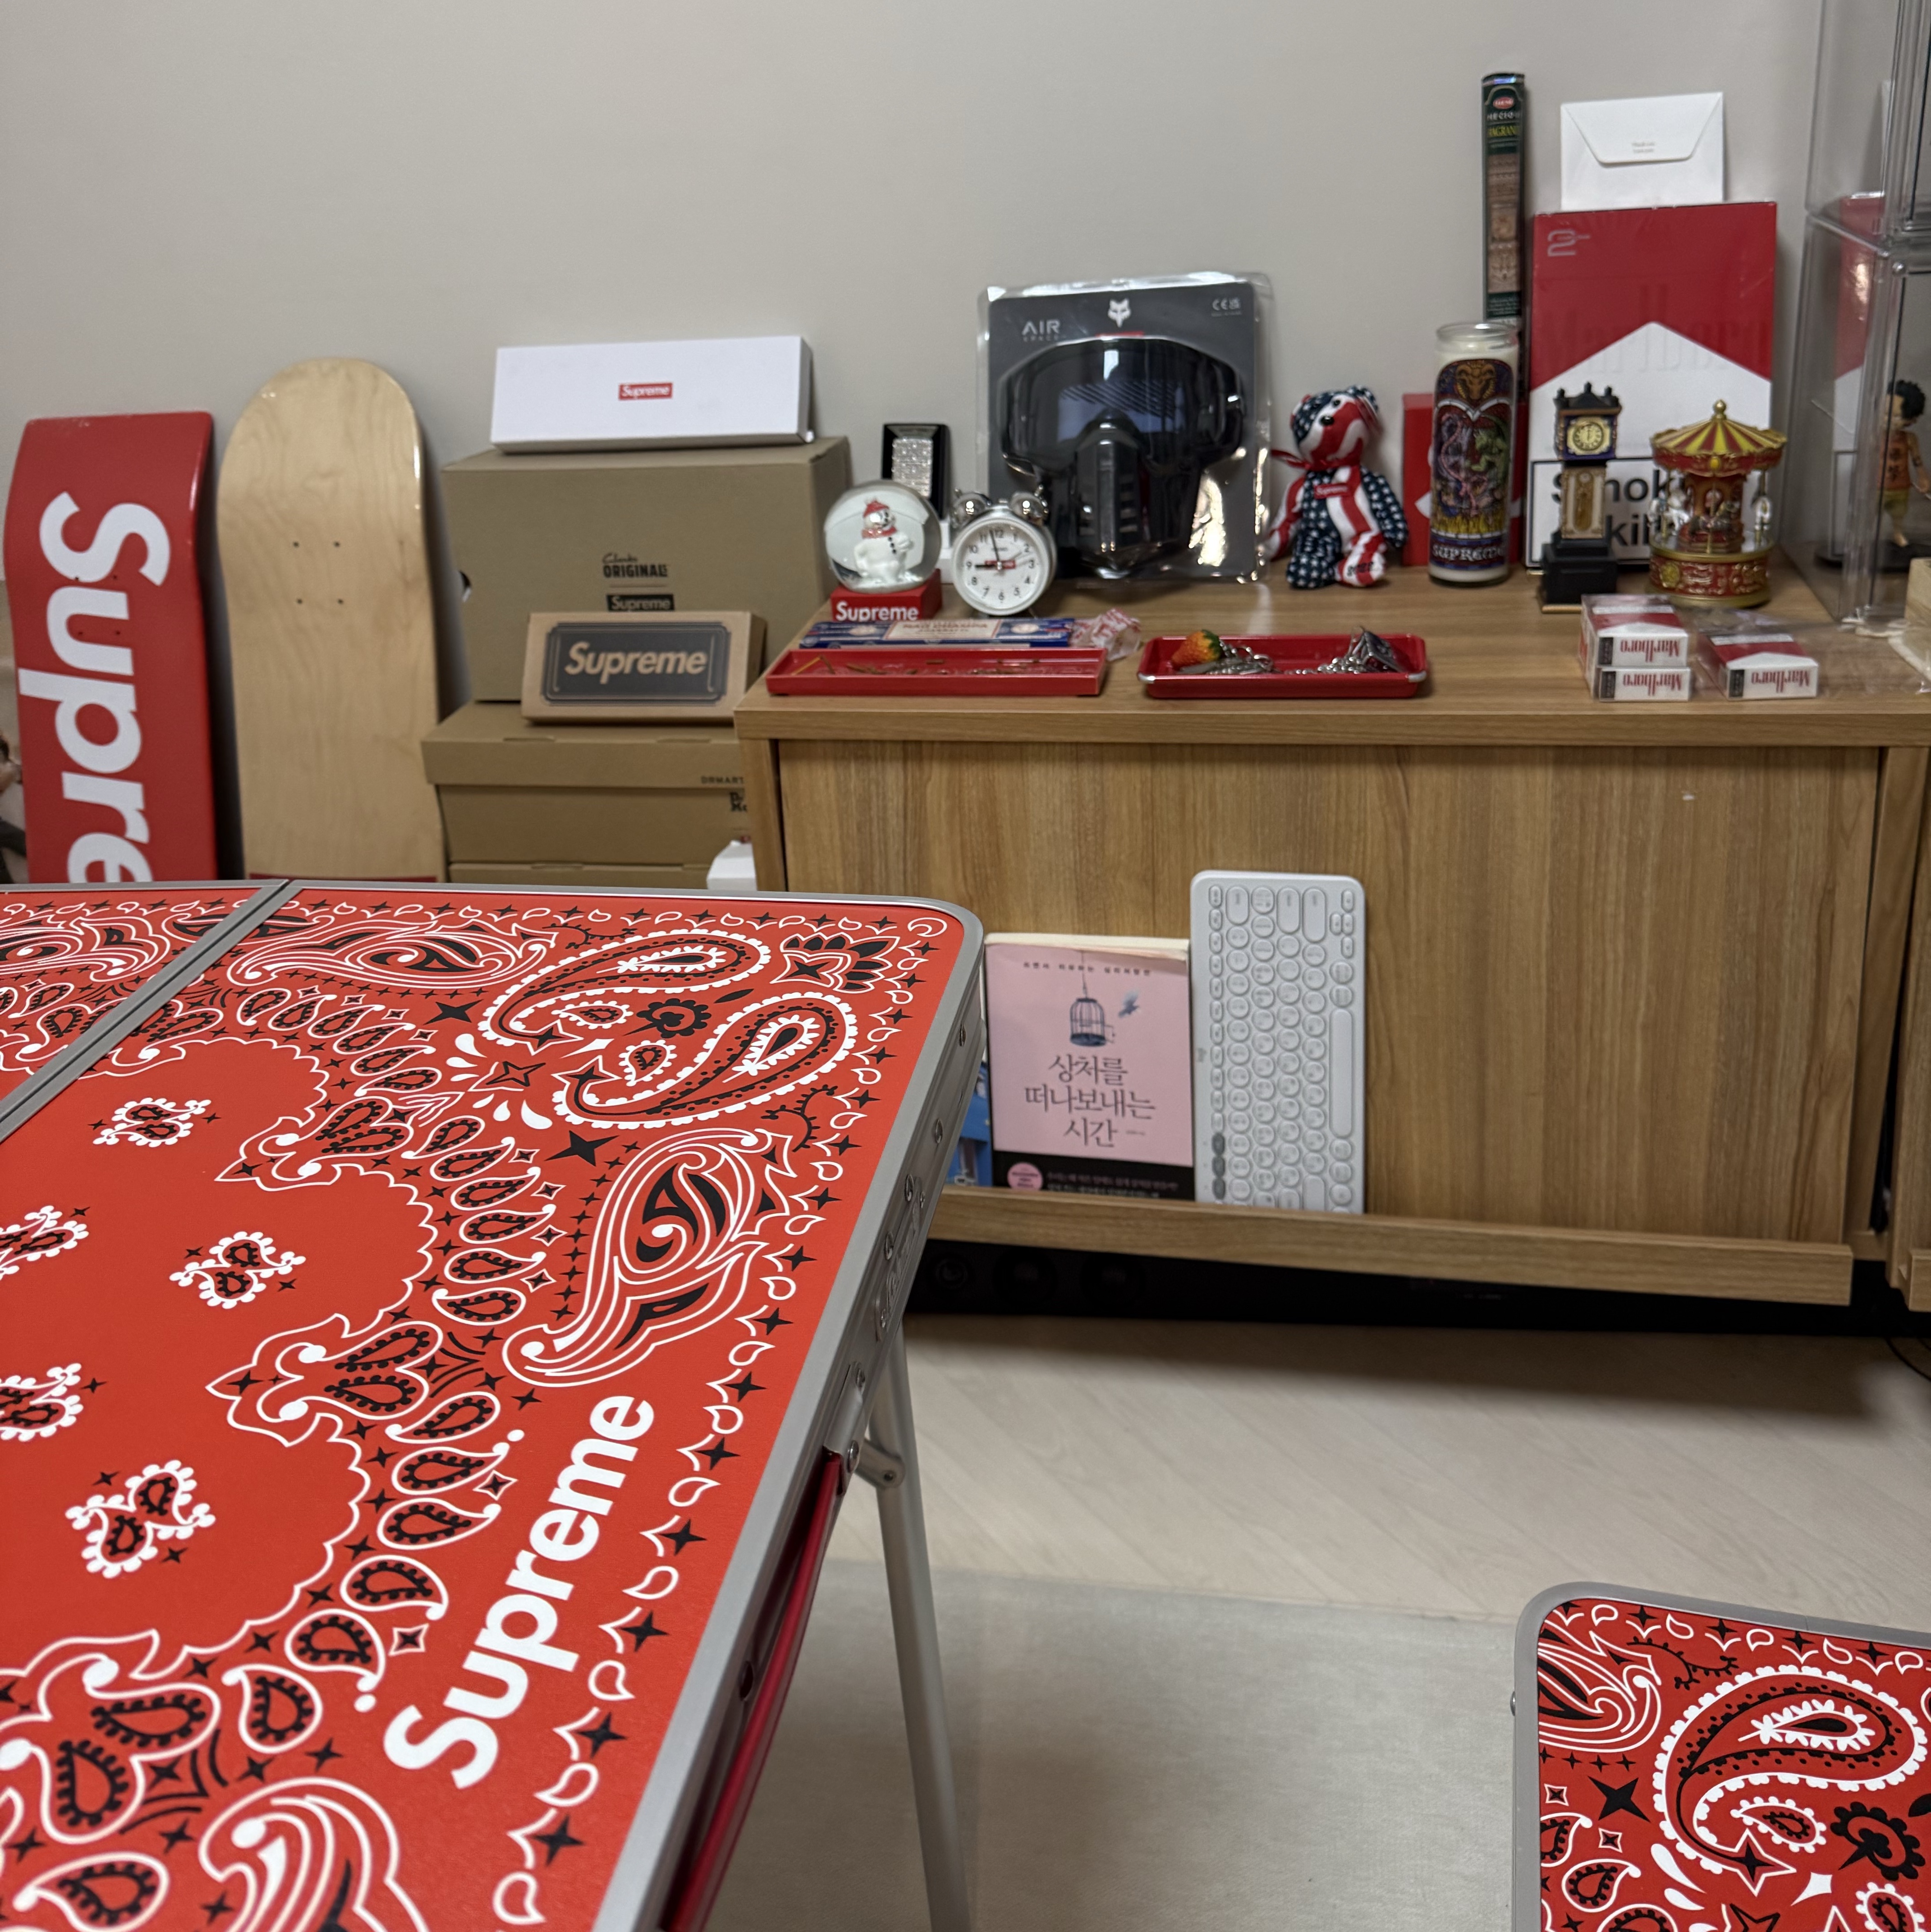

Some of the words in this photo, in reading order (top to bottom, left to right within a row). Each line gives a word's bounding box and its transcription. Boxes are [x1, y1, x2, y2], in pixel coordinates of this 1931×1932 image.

[1022, 319, 1060, 335] AIR
[622, 385, 670, 399] Supreme
[836, 601, 919, 622] Supreme
[564, 642, 708, 684] Supreme
[1620, 639, 1679, 663] Marlboro
[1623, 674, 1682, 696] Marlboro
[1751, 670, 1810, 693] Marlboro
[1048, 1054, 1128, 1086] 상처를
[1024, 1083, 1156, 1120] 떠나보내는
[1063, 1117, 1118, 1147] 시간
[383, 1395, 654, 1789] Supreme
